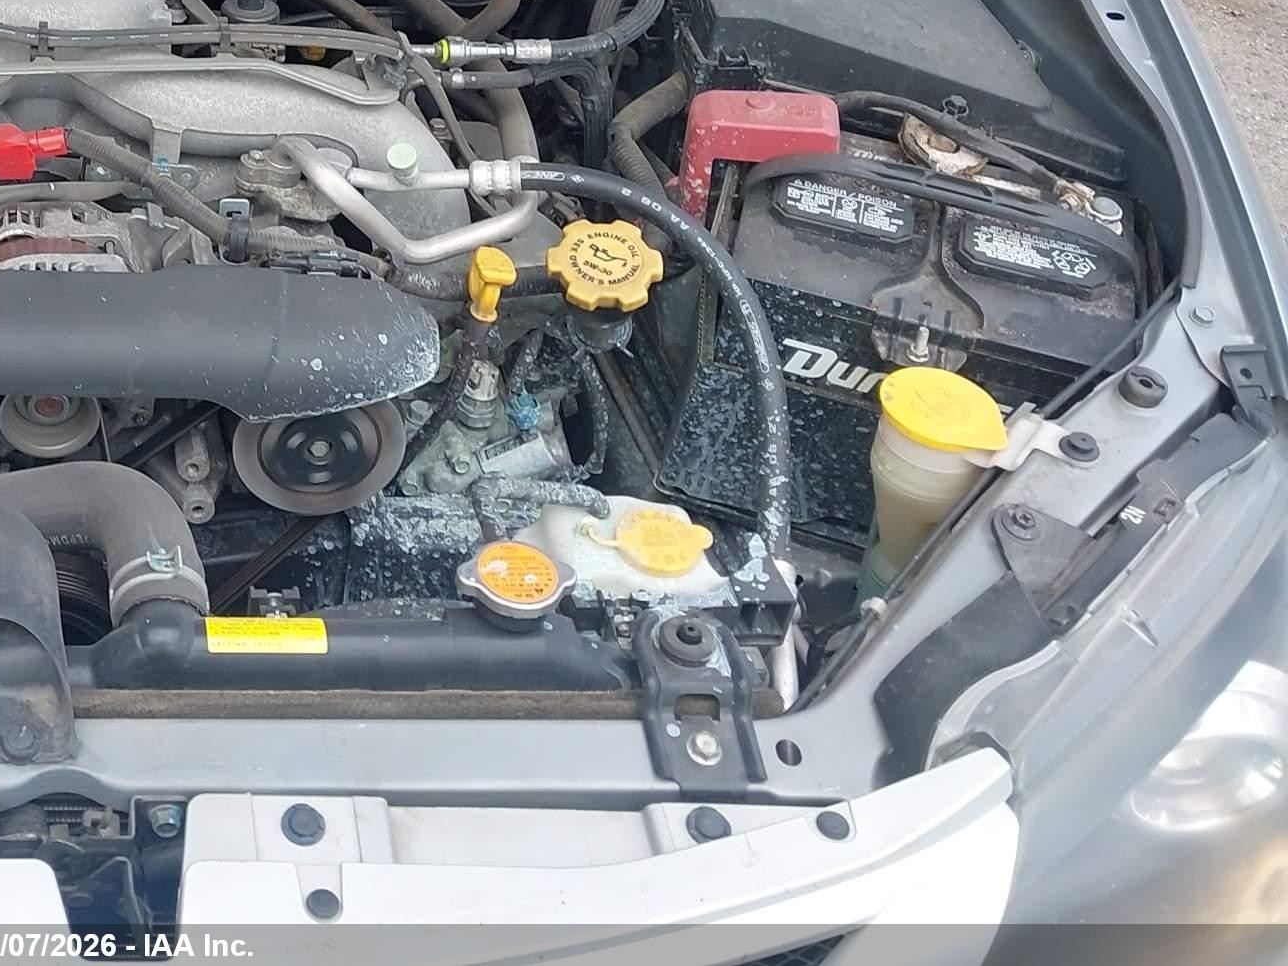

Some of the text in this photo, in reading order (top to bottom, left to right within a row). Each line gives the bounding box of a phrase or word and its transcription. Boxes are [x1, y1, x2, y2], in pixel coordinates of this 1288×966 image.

[804, 180, 848, 196] DANGER
[858, 193, 898, 208] POISON
[587, 232, 640, 258] ENGINE OIL
[569, 238, 640, 285] SEE OWNER'S MANUAL
[583, 260, 613, 276] 5W-30
